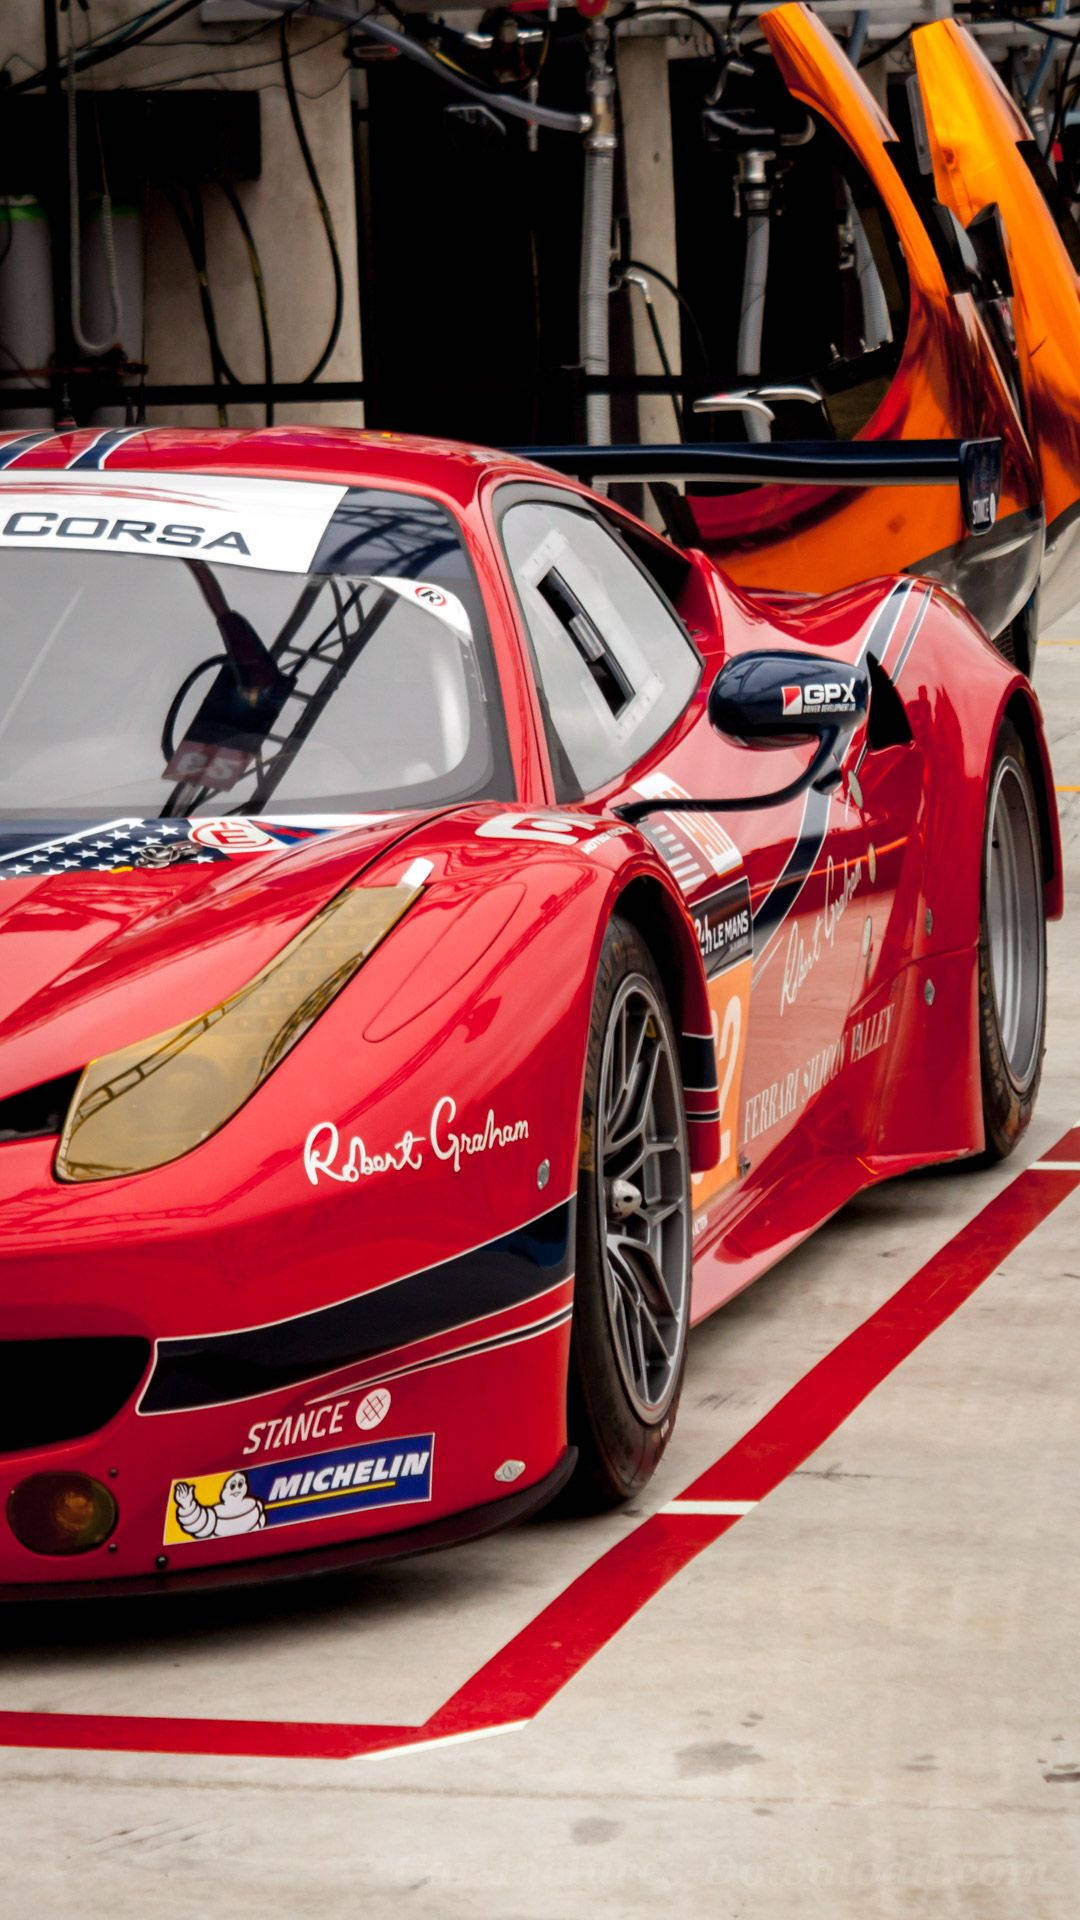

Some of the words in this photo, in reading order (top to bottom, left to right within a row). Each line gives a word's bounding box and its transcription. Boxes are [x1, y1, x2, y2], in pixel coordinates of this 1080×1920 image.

[2, 511, 252, 556] CORSA
[803, 677, 857, 704] GPX
[713, 923, 724, 950] LE
[724, 910, 749, 944] MANS
[744, 1068, 799, 1144] FERRARI
[802, 1031, 849, 1103] SILICON
[850, 1003, 896, 1064] VALLEY
[303, 1121, 426, 1185] Robert
[430, 1096, 529, 1172] Graham
[242, 1400, 350, 1455] STANCE
[268, 1452, 430, 1501] MICHELIN
